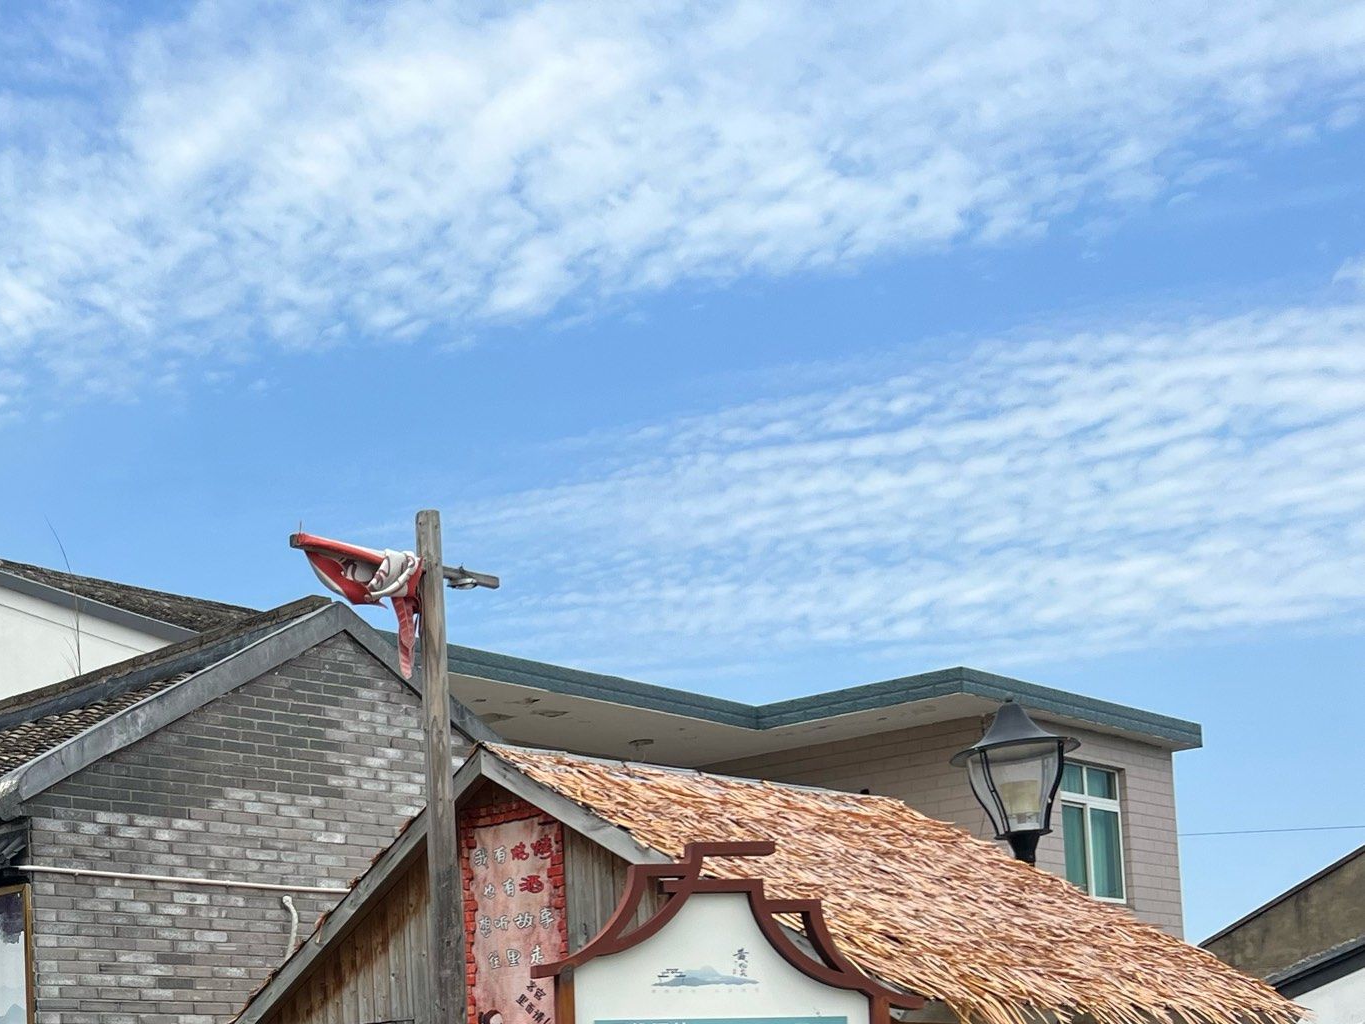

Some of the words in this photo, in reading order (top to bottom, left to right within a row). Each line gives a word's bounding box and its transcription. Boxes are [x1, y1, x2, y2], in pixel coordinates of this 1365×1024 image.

[484, 875, 544, 899] 也有酒
[478, 906, 556, 938] 想听故事
[488, 945, 545, 969] 往里走
